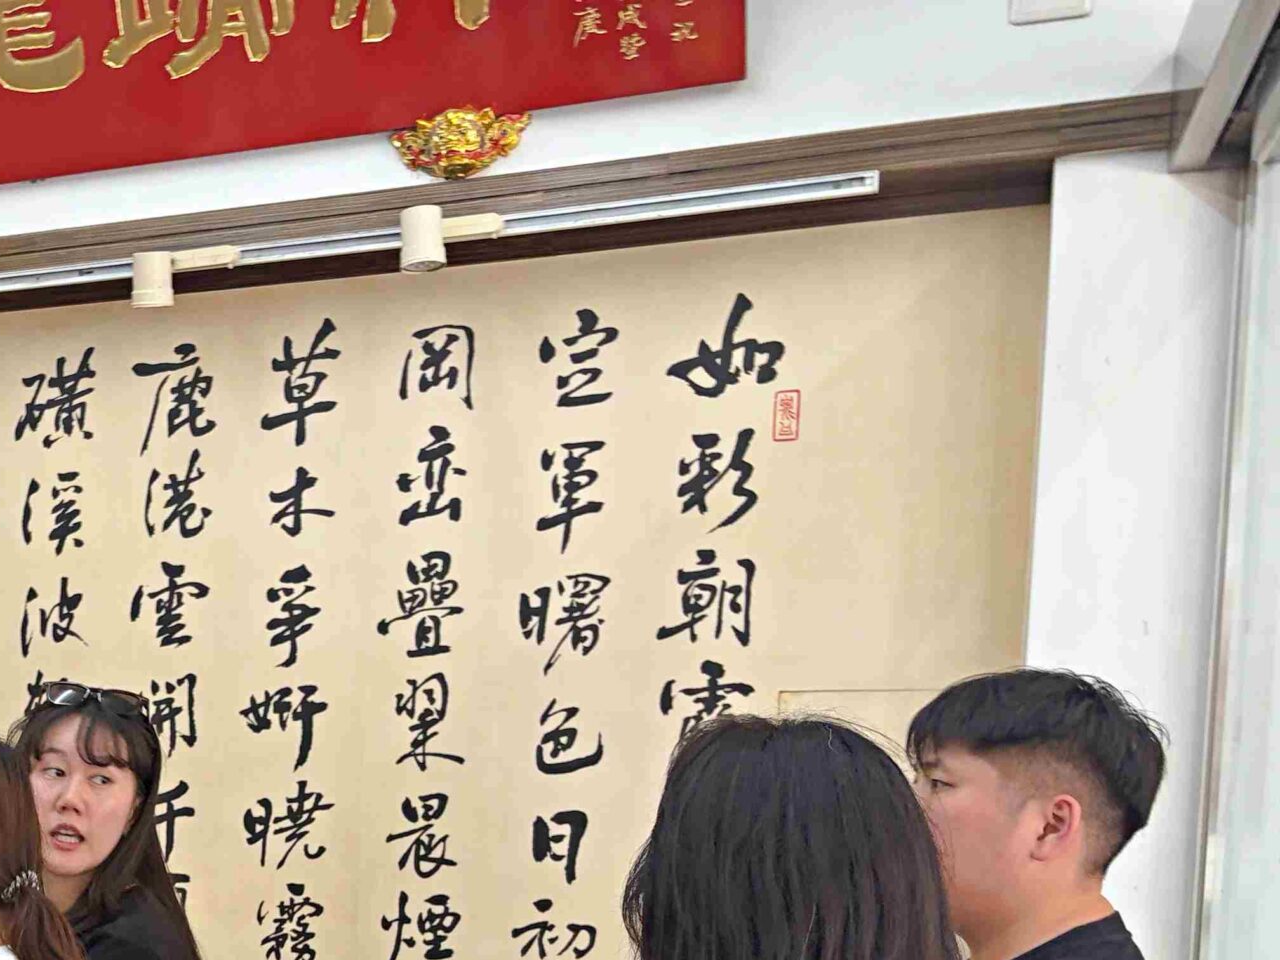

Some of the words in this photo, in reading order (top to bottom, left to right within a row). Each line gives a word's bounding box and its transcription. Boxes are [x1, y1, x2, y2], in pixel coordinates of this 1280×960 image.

[130, 342, 217, 907] 鹿港雲開千
